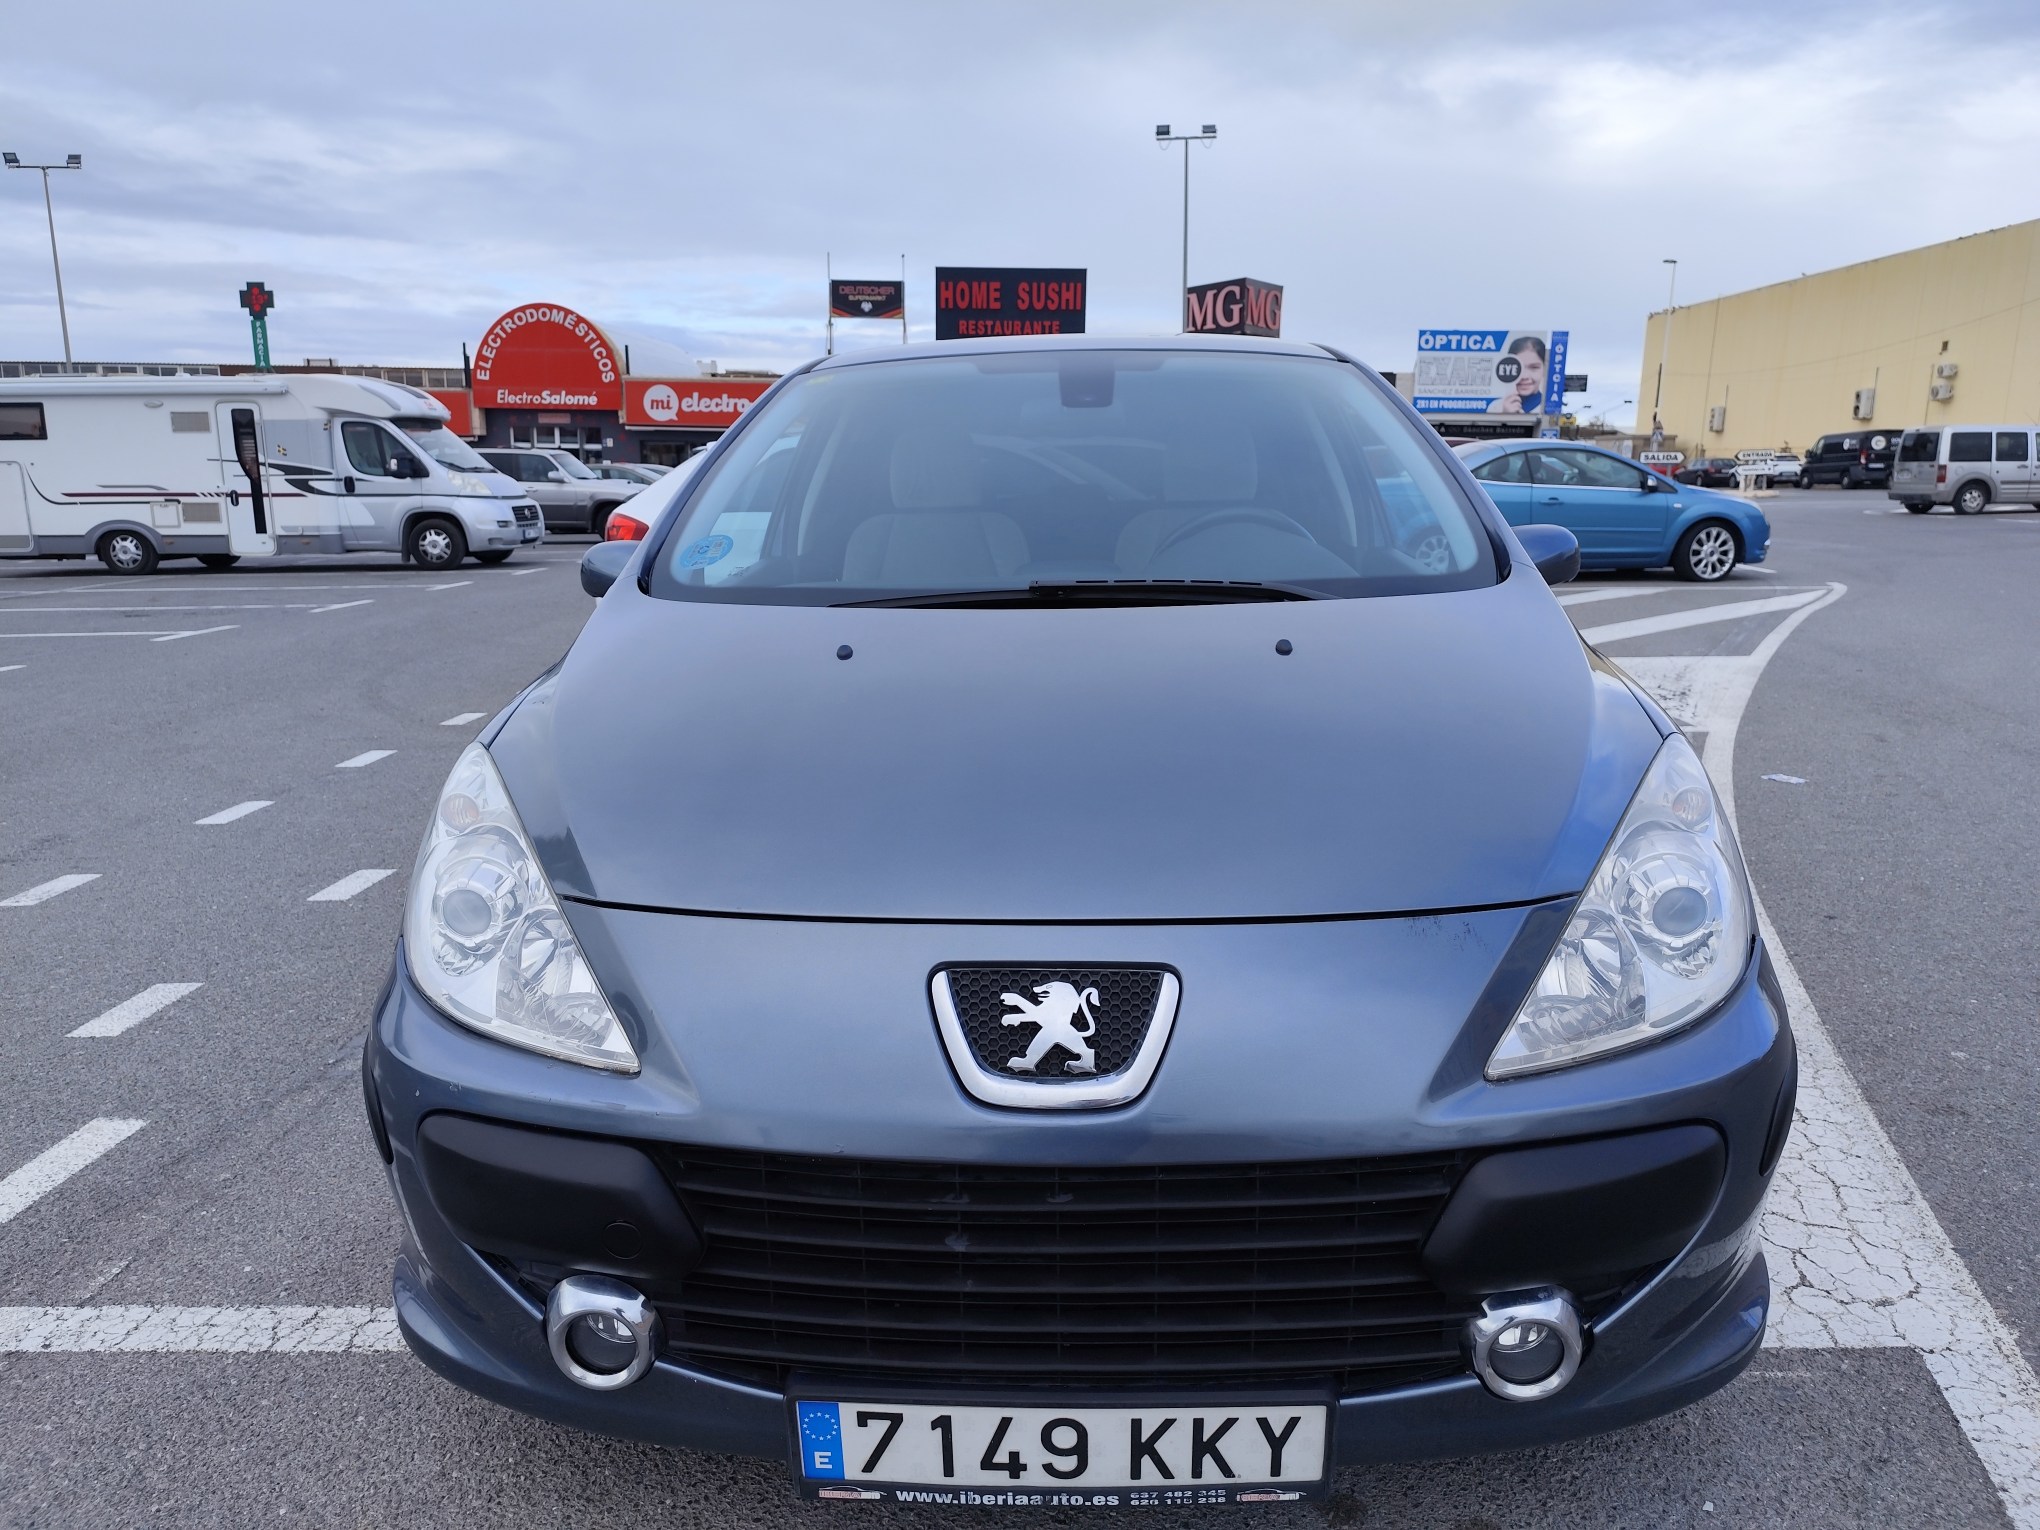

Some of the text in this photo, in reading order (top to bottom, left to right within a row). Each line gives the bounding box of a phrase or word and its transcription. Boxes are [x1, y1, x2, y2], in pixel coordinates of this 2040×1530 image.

[839, 286, 895, 295] DEUTSCHER
[940, 281, 1082, 310] HOME SUSHI
[1186, 285, 1243, 331] MG
[1246, 284, 1281, 330] MG
[958, 320, 1060, 336] RESTAURANTE
[255, 321, 266, 367] FARMACIA
[476, 307, 616, 383] ELECTRODOMÉSTICOS
[1420, 331, 1497, 350] ÓPTICA
[1498, 363, 1519, 377] EYE
[496, 388, 598, 405] ElectroSalomé
[650, 391, 751, 413] mi electro
[857, 1411, 1302, 1480] 7149 KKY
[814, 1452, 832, 1469] E
